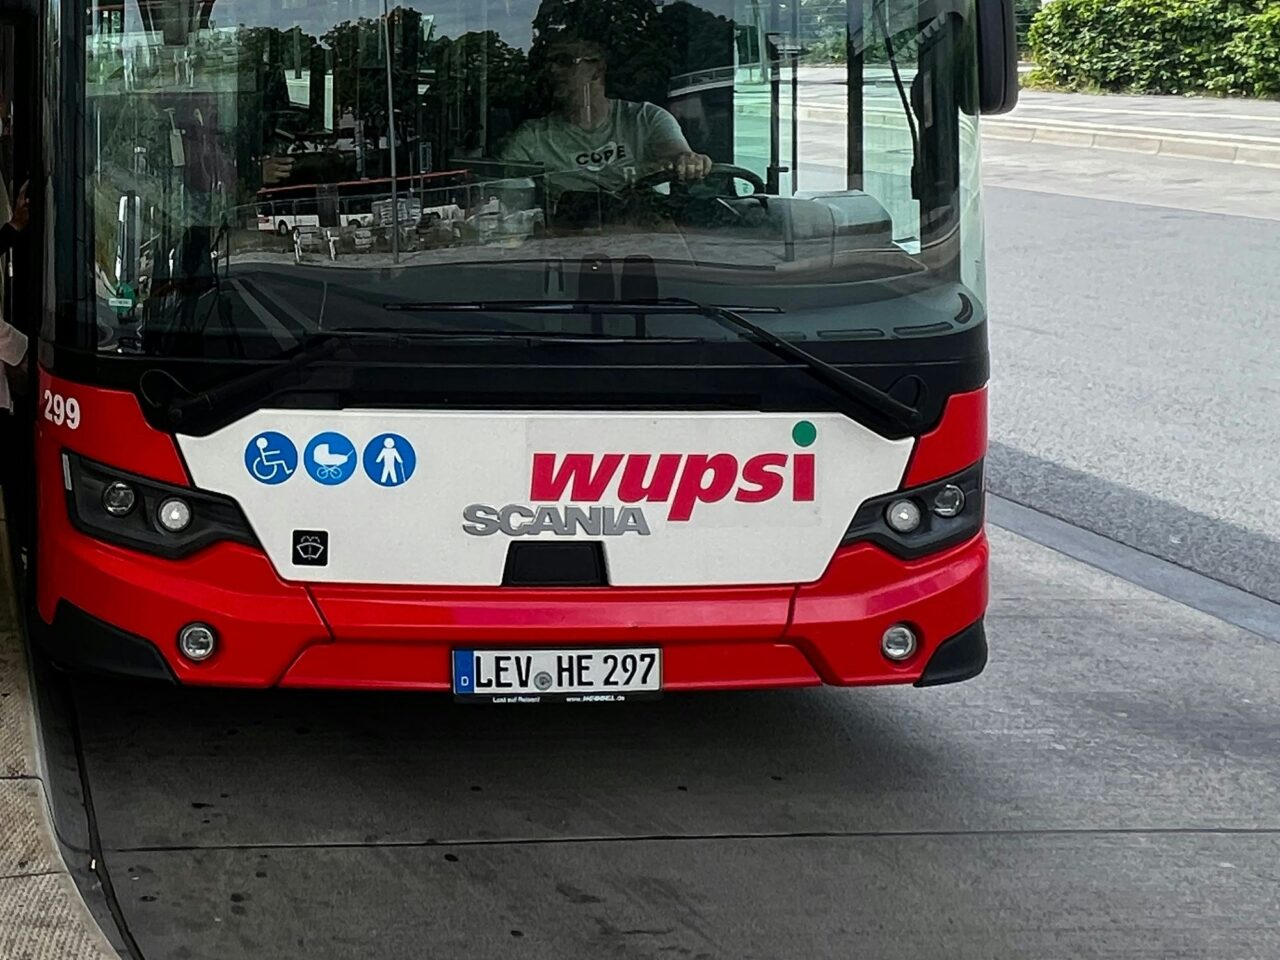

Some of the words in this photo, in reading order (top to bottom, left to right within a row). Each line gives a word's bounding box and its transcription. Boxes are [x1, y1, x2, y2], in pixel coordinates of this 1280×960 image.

[44, 389, 81, 430] 299
[529, 420, 817, 522] wupsi
[462, 503, 651, 537] SCANIA
[460, 676, 469, 687] D
[475, 655, 532, 688] LEV
[556, 654, 594, 687] HE
[602, 653, 656, 686] 297
